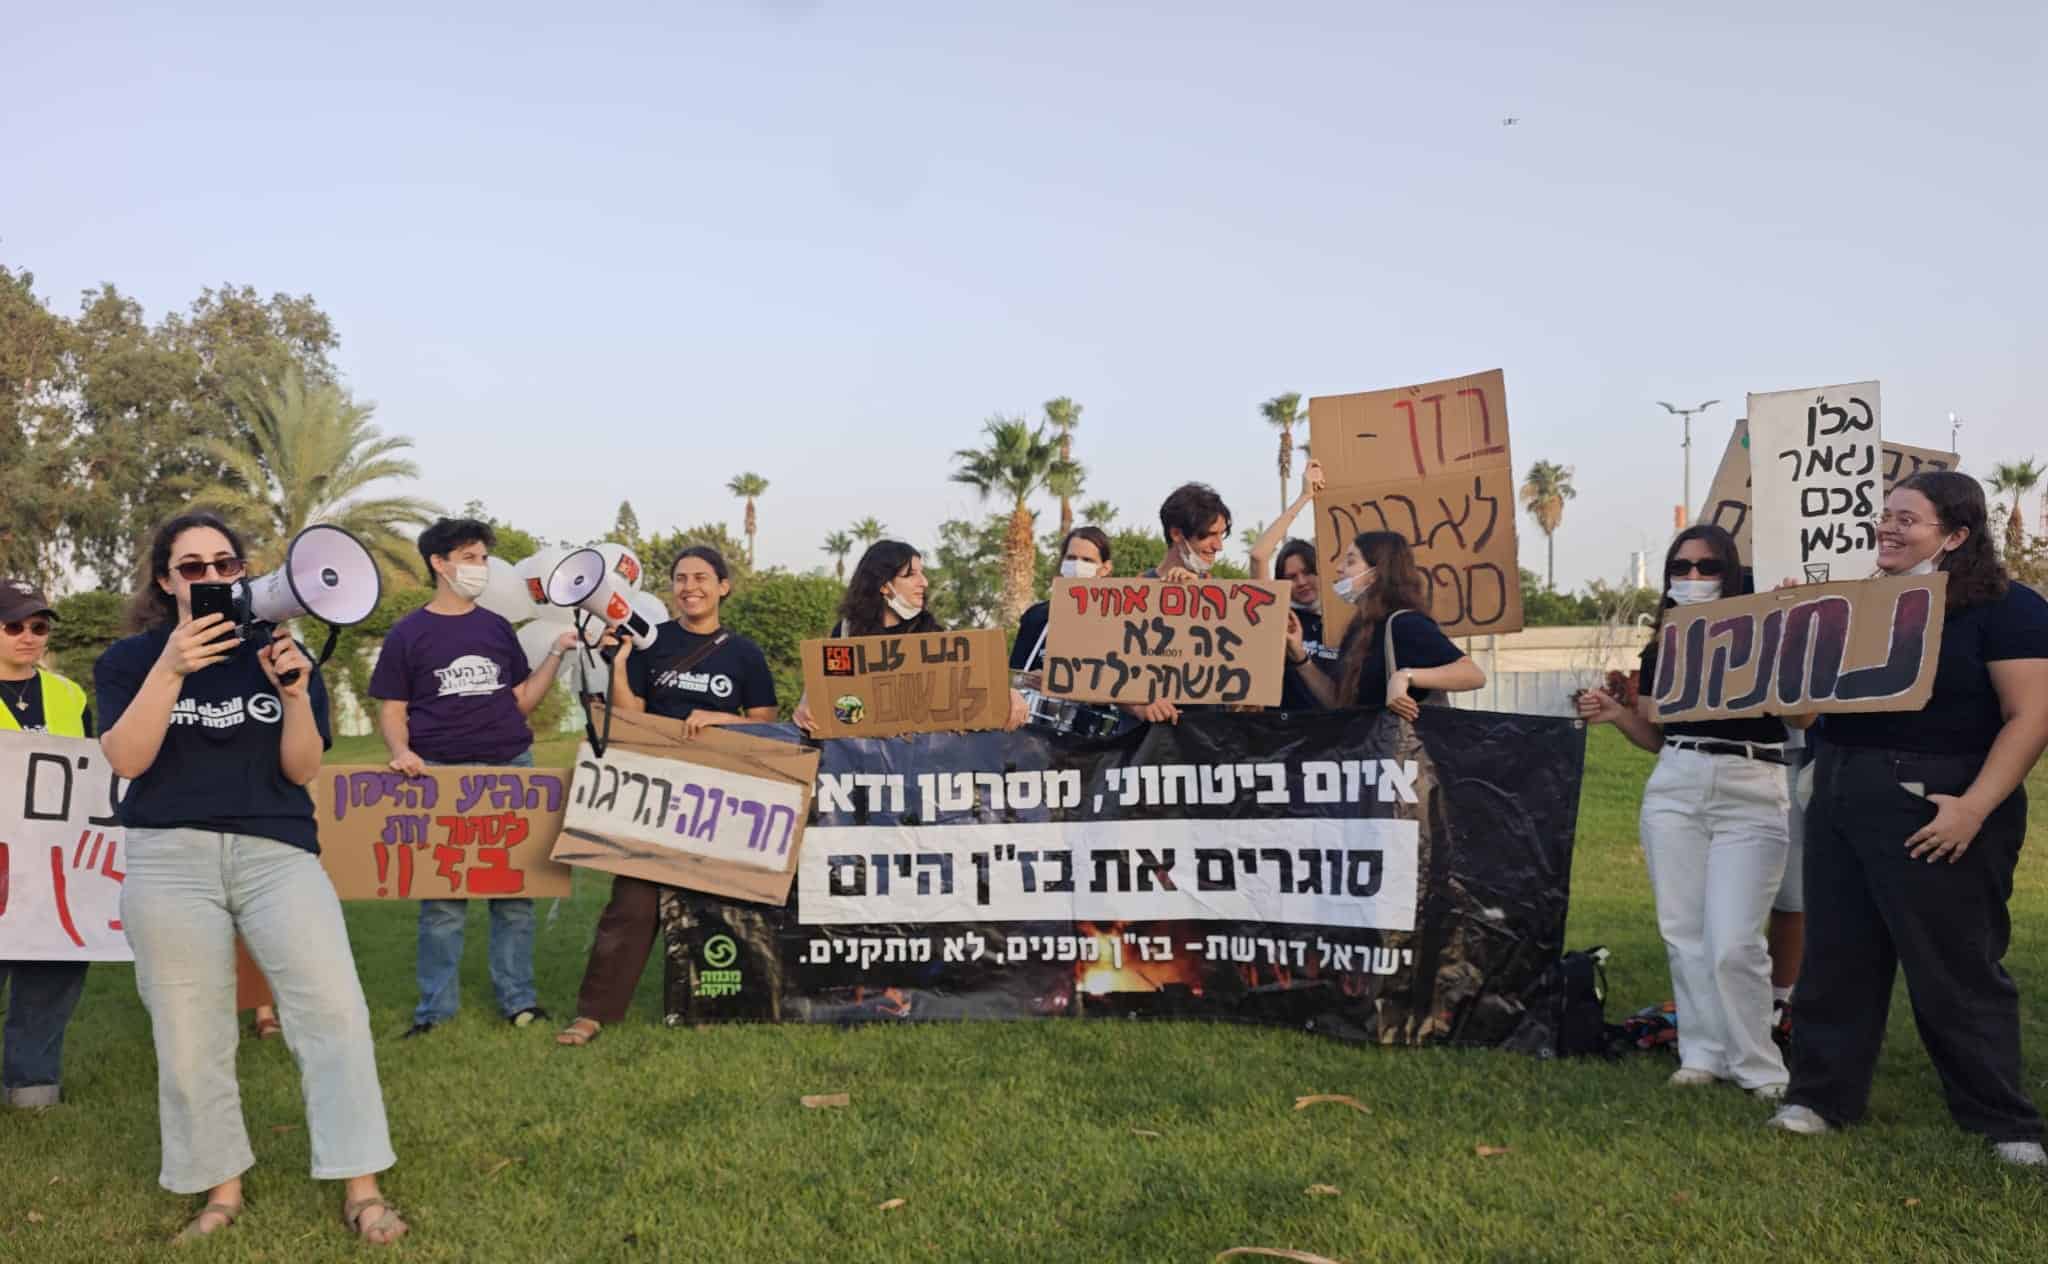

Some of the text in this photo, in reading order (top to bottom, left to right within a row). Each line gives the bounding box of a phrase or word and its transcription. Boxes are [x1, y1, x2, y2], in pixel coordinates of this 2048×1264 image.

[1779, 444, 1874, 482] נגמר
[1801, 480, 1875, 517] לכם
[1801, 521, 1876, 563] הזמן
[1123, 617, 1243, 661] זה לא
[1048, 652, 1141, 697] ילדים
[456, 774, 562, 813] הגיע
[917, 768, 1081, 822] מסרטן
[1093, 762, 1290, 813] ביטחוני,
[1301, 759, 1419, 803] איום
[827, 844, 1384, 906] סוגרים את בז"ן היום
[800, 937, 931, 970] מתקנים.
[943, 931, 985, 963] לא
[997, 936, 1099, 965] מפנים,
[1112, 933, 1174, 969] בז"ן
[1317, 936, 1413, 975] ישראל
